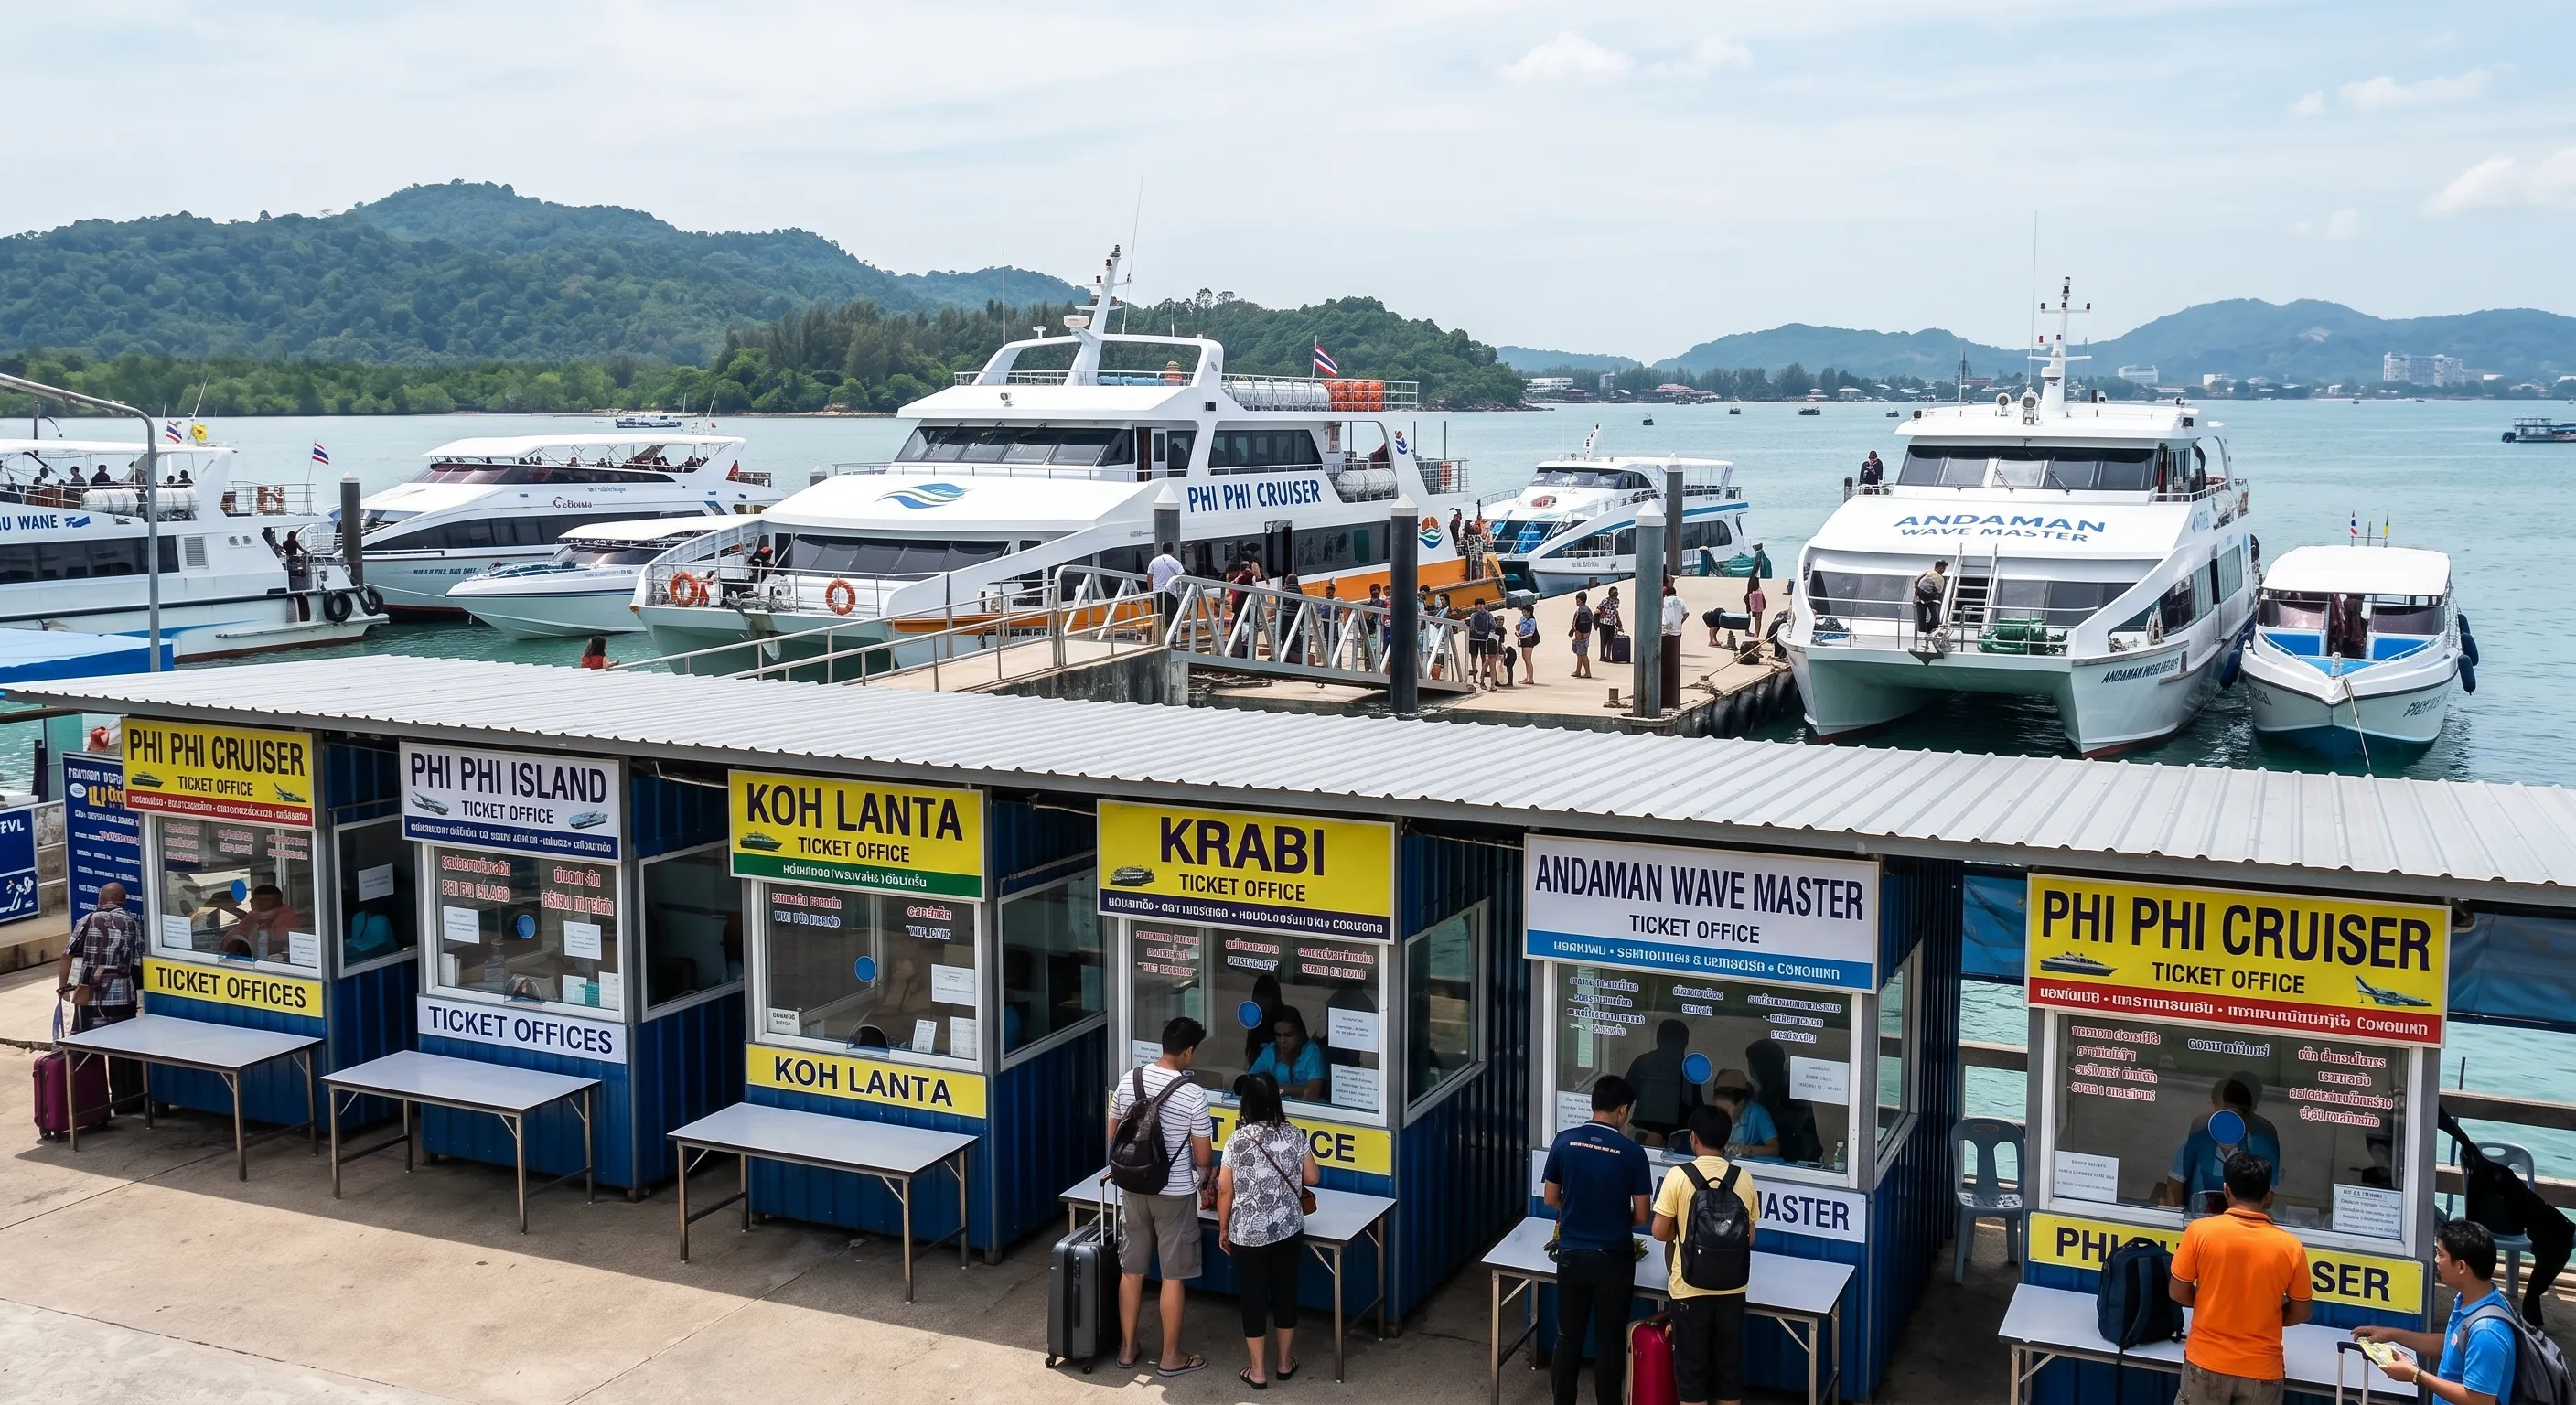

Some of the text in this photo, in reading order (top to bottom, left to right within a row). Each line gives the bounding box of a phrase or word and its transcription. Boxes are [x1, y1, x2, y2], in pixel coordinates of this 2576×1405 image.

[1187, 479, 1321, 512] PHI PHI CRUISER
[0, 515, 58, 531] U WANE
[1893, 514, 2105, 533] ANDAMAN
[1901, 528, 2088, 542] WAVE MASTER
[129, 729, 306, 777] PHI PHI CRUISER
[177, 776, 253, 797] TICKET OFFICE
[411, 752, 606, 803] PHI PHI ISLAND
[461, 800, 554, 824] TICKET OFFICE
[746, 782, 963, 841] KOH LANTA
[798, 836, 910, 863] TICKET OFFICE
[1160, 816, 1325, 876] KRABI
[1178, 874, 1305, 902] TICKET OFFICE
[1535, 854, 1864, 921] ANDAMAN WAVE MASTER
[1629, 914, 1760, 944] TICKET OFFICE
[2042, 889, 2431, 971] PHI PHI CRUISER
[156, 966, 306, 1008] TICKET OFFICES
[2152, 961, 2305, 994] TICKET OFFICE
[428, 1006, 612, 1054] TICKET OFFICES
[775, 1056, 953, 1107] KOH LANTA
